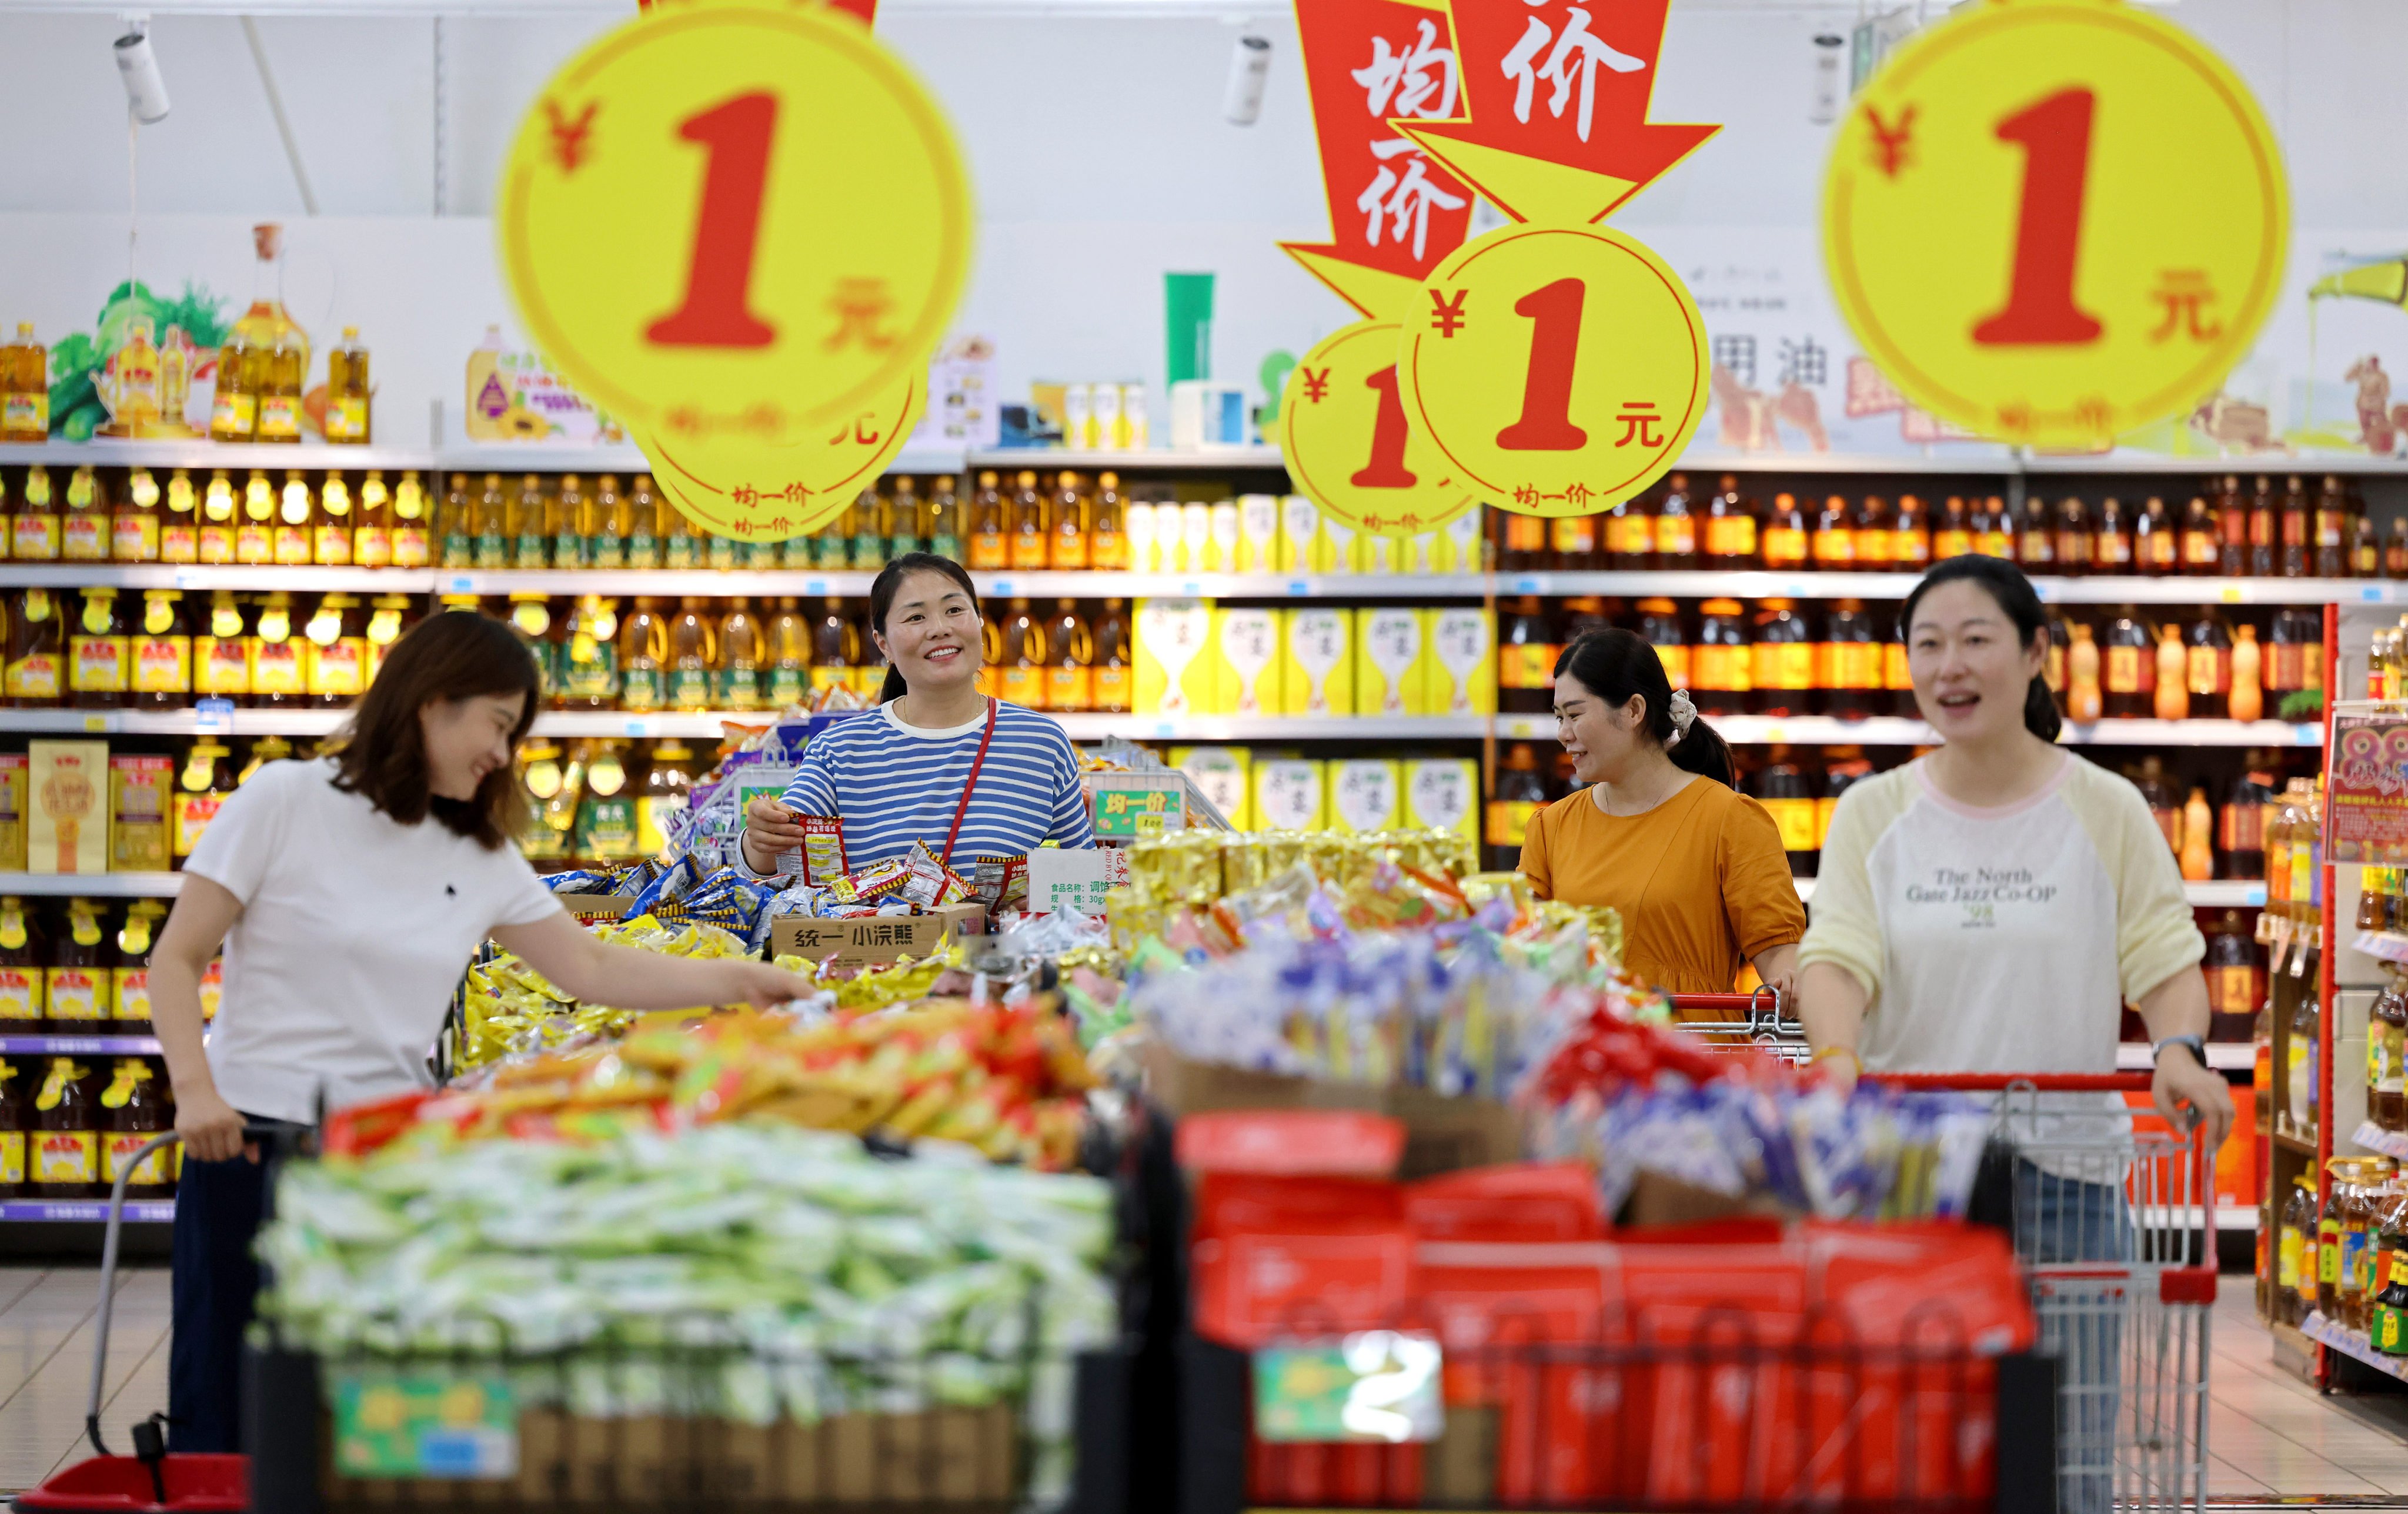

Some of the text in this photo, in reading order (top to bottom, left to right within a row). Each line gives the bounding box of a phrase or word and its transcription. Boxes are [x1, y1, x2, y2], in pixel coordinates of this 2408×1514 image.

[1501, 0, 1646, 143] 价
[1351, 18, 1466, 261] 均一价
[644, 92, 777, 347] 1
[1970, 88, 2103, 346] 1
[1496, 278, 1588, 450] 1
[1615, 403, 1664, 447] 元
[1350, 363, 1418, 488] 1
[732, 482, 814, 507] 均一价
[1512, 483, 1597, 509] 均一价
[733, 517, 796, 537] 均一价
[1362, 512, 1424, 532] 均一价
[1105, 792, 1168, 814] 均一价
[1051, 883, 1084, 893] 食品名称：
[1935, 867, 2033, 884] The North
[1952, 887, 1991, 902] Jazz
